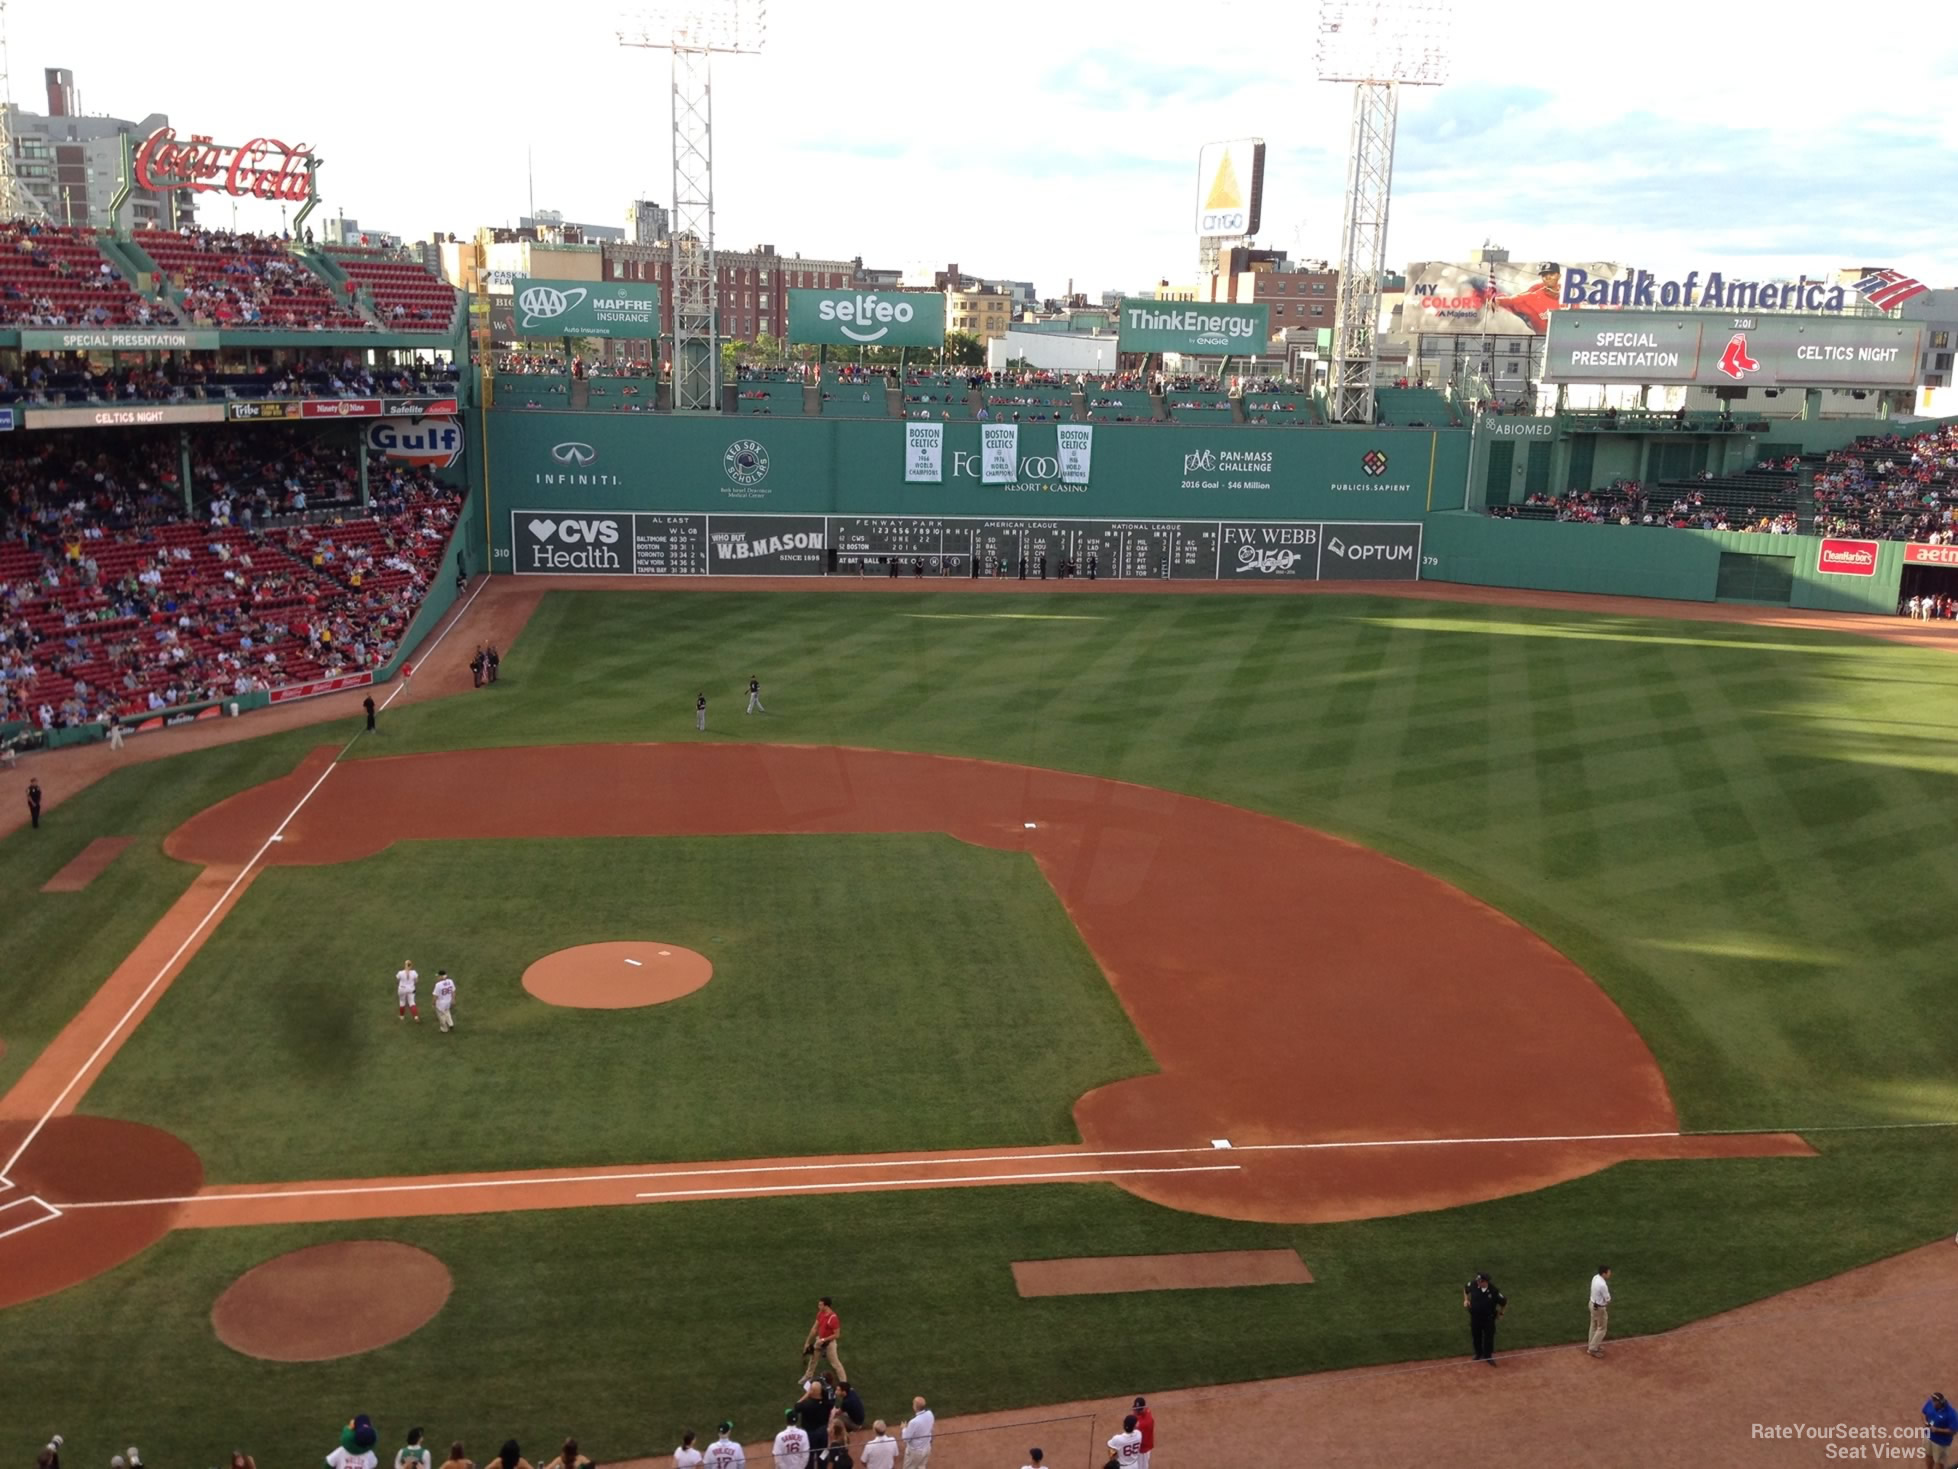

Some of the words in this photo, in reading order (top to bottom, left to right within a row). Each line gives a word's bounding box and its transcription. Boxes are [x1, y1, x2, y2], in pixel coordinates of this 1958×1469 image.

[135, 127, 316, 202] Coca-Cola
[1203, 213, 1243, 231] CITGO
[1414, 284, 1437, 295] MY
[1563, 267, 1656, 306] Bank
[1660, 271, 1698, 307] of
[1700, 272, 1845, 311] America
[522, 288, 562, 317] AAA
[593, 299, 652, 310] MAPFRE
[1422, 297, 1484, 309] COLORS
[597, 312, 649, 322] INSURANCE
[1128, 309, 1254, 337] ThinkEnergy
[493, 321, 507, 330] We
[1734, 320, 1751, 328] 7:01
[63, 335, 109, 346] SPECIAL
[112, 335, 186, 346] PRESENTATION
[1596, 333, 1658, 347] SPECIAL
[1571, 352, 1679, 367] PRESENTATION
[1797, 346, 1854, 360] CELTICS
[1859, 347, 1898, 361] NIGHT
[231, 403, 259, 418] Tribe
[317, 404, 338, 413] Ninety
[390, 406, 423, 414] Safelite
[95, 413, 135, 424] CELTICS
[137, 412, 164, 422] NIGHT
[909, 429, 940, 438] BOSTON
[985, 430, 1014, 439] BOSTON
[1060, 431, 1089, 440] BOSTON
[1495, 424, 1552, 435] ABIOMED
[371, 424, 456, 449] Gulf
[910, 438, 938, 448] CELTICS
[986, 440, 1013, 448] CELTICS
[1061, 441, 1087, 450] CELTICS
[726, 443, 741, 461] RED
[743, 441, 761, 454] SOX
[1220, 451, 1273, 461] PAN-MASS
[727, 458, 767, 483] SCHOLARS
[1218, 463, 1272, 472] CHALLENGE
[536, 474, 617, 486] INFINITI
[1228, 481, 1241, 489] $46
[1004, 483, 1041, 492] RESORT
[1050, 483, 1088, 492] CASINO
[1331, 484, 1411, 492] PUBLICIS.SAPIENT
[558, 519, 619, 543] CVS
[1224, 528, 1256, 544] F.W.
[1262, 528, 1317, 544] WEBB
[711, 534, 729, 542] WHO
[717, 532, 824, 559] W.B.MASON
[494, 548, 510, 558] 310
[532, 545, 620, 568] Health
[1348, 545, 1413, 560] OPTUM
[1823, 550, 1872, 565] CleanHarbors
[1422, 557, 1438, 565] 379
[785, 1442, 800, 1454] 16
[1123, 1442, 1140, 1456] 65
[716, 1456, 732, 1469] 17
